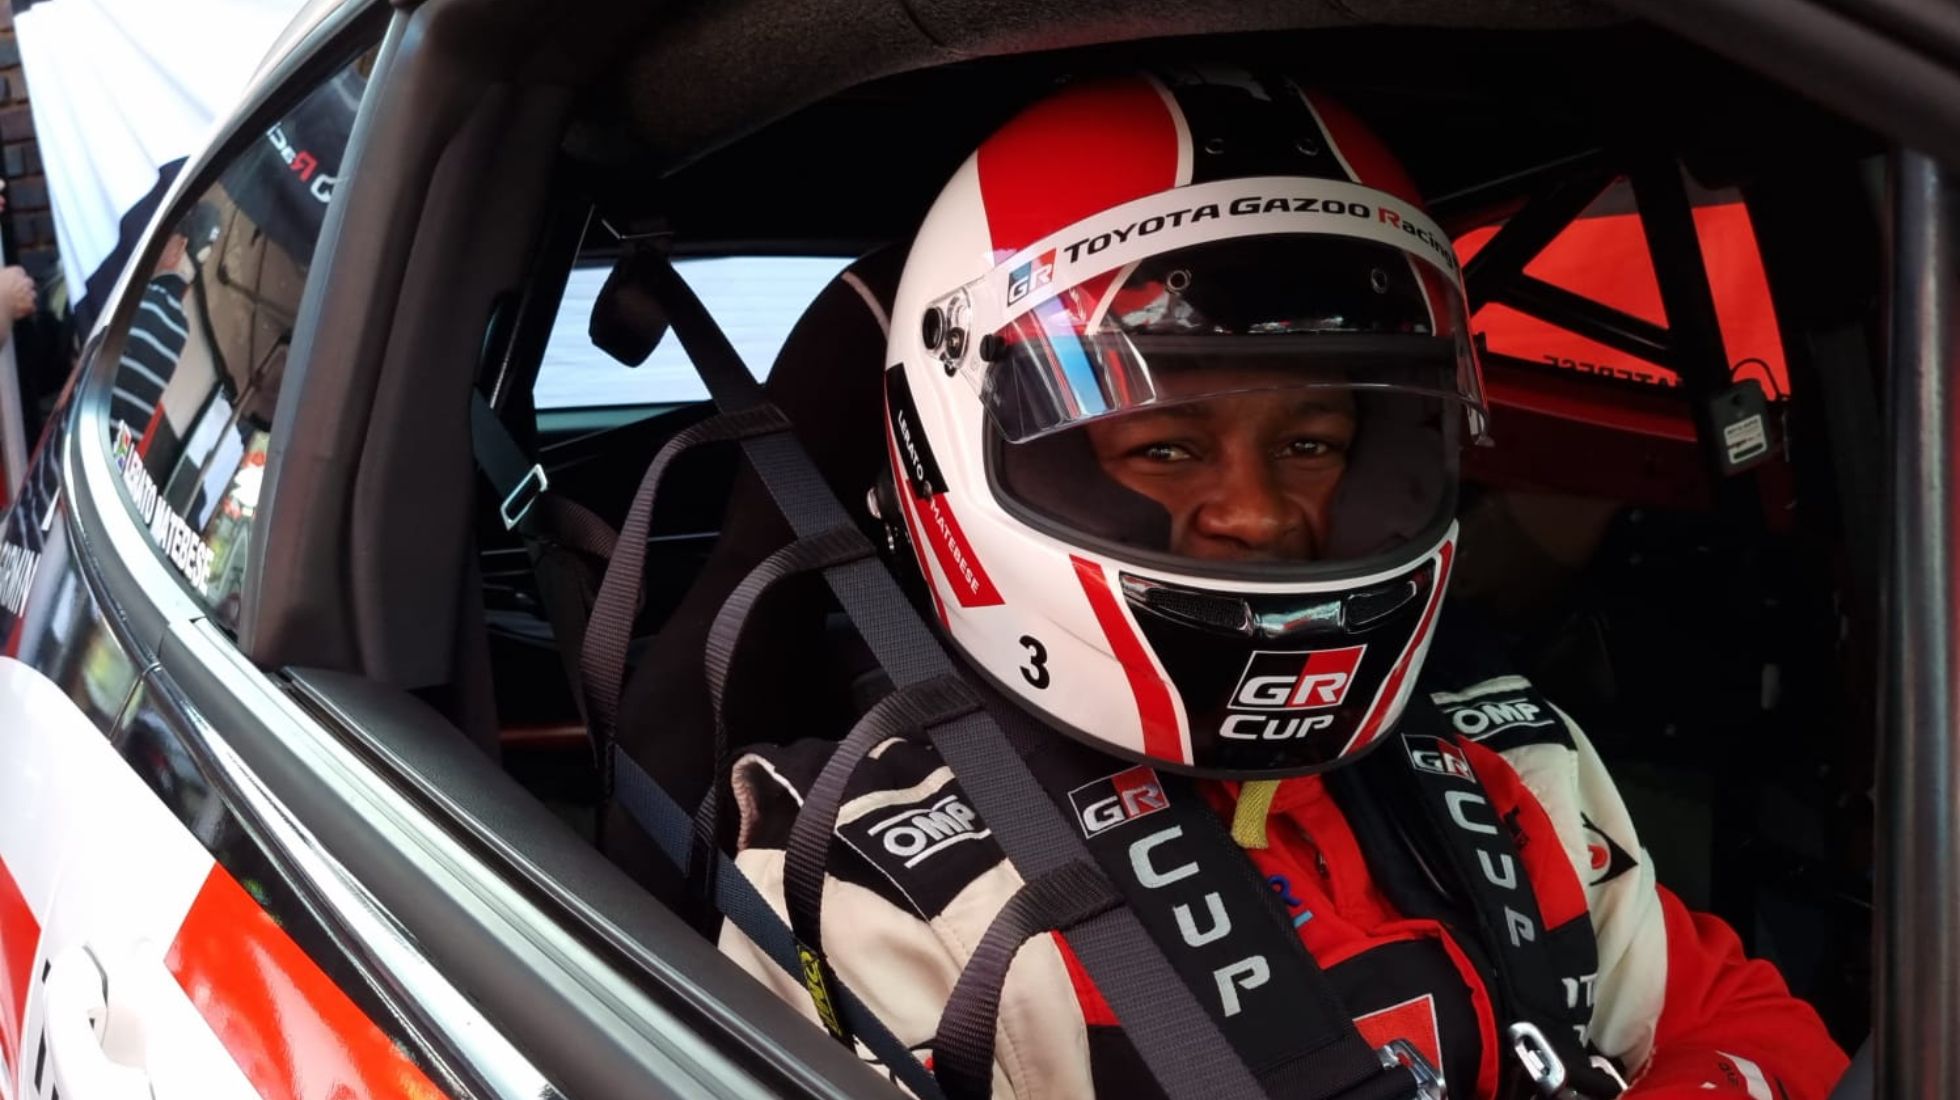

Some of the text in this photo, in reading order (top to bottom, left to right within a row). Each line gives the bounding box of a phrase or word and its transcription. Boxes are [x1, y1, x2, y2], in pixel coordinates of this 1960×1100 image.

[1008, 265, 1054, 304] GR
[1063, 203, 1220, 264] TOYOTA
[1228, 196, 1371, 219] GAZOO
[897, 410, 924, 482] LERATO
[930, 499, 980, 596] MATEBESE
[1018, 634, 1050, 690] 3
[1238, 672, 1348, 705] GR
[1452, 702, 1541, 734] OMP
[1411, 750, 1469, 777] GR
[882, 801, 976, 858] OMP
[1082, 783, 1164, 832] GR
[1444, 790, 1536, 947] CUP
[1128, 825, 1271, 1018] CUP
